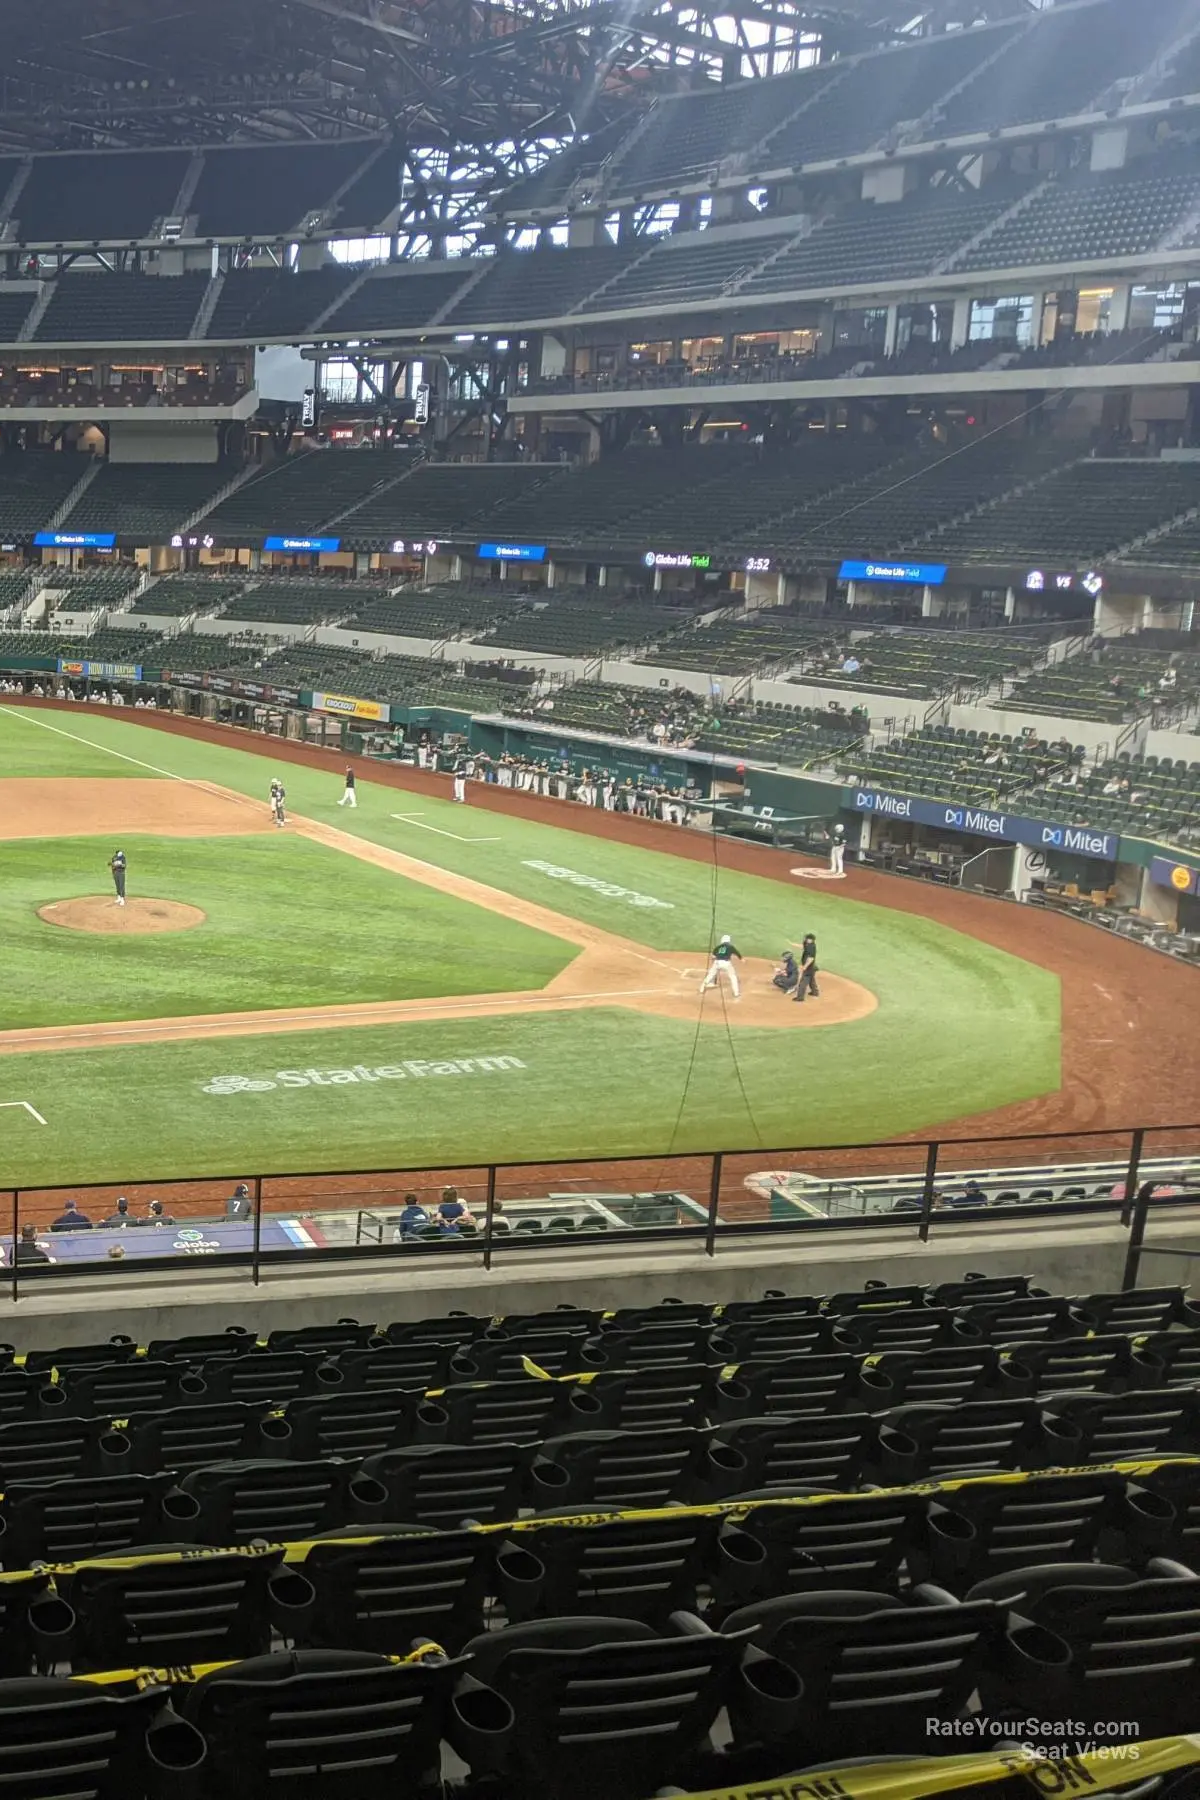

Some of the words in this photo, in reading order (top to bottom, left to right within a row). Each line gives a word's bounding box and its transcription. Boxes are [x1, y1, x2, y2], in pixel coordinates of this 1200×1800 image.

[412, 543, 423, 552] VS
[656, 554, 678, 565] Globe
[678, 555, 692, 566] Life
[692, 555, 710, 567] Field
[746, 557, 770, 570] 3:52
[1056, 576, 1072, 588] VS
[875, 795, 911, 817] Mitel
[965, 811, 1006, 834] Mitel
[1064, 831, 1109, 855] Mitel
[233, 1201, 241, 1213] 7
[173, 1240, 221, 1249] Globe
